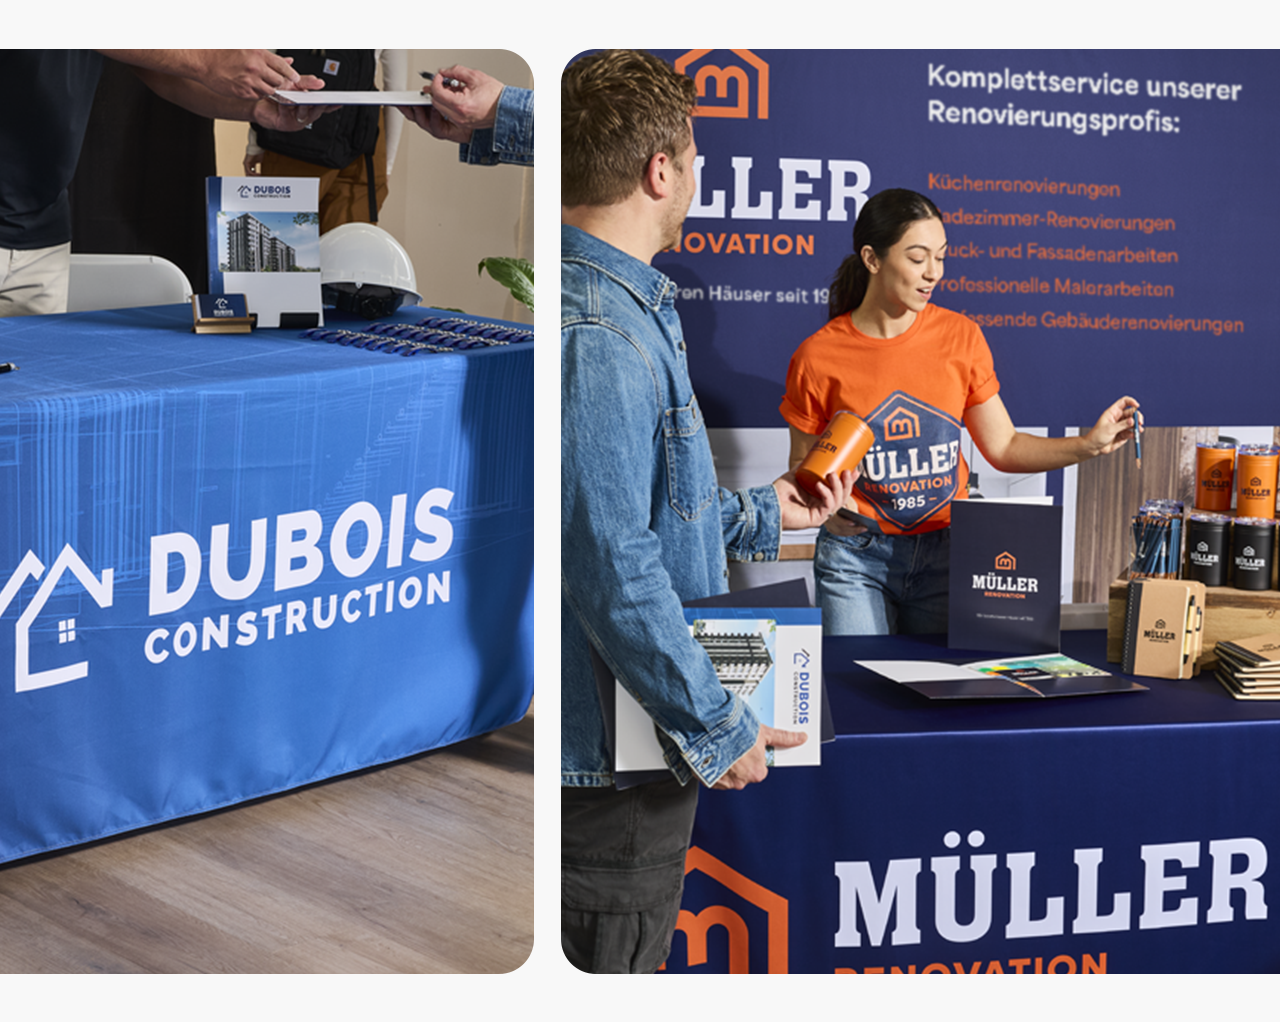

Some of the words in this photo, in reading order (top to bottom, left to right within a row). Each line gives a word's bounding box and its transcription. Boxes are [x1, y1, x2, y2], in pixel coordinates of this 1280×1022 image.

[928, 63, 1139, 95] Komplettservice
[1146, 79, 1243, 100] unserer
[928, 100, 1180, 136] Renovierungsprofis:
[254, 185, 291, 194] DUBOIS
[928, 173, 1121, 200] Küchenrenovierungen
[939, 208, 1176, 234] adezimmer-Renovierungen
[663, 232, 815, 255] OVATION
[989, 242, 1022, 259] und
[1027, 243, 1179, 264] Fassadenarbeiten
[709, 286, 772, 302] Häuser
[776, 289, 808, 304] seit
[937, 276, 1050, 294] rofessionelle
[1054, 277, 1174, 298] Malerarbeiten
[1041, 311, 1244, 336] Gebäuderenovierungen
[859, 440, 959, 482] ÜLLER
[864, 475, 952, 494] RENOVATION
[892, 495, 925, 510] 1985
[148, 487, 455, 616] DUBOIS
[972, 572, 1038, 592] MÜLLER
[144, 570, 451, 664] CONSTRUCTION
[799, 672, 810, 724] DUBOIS
[834, 830, 1269, 948] MÜLLER
